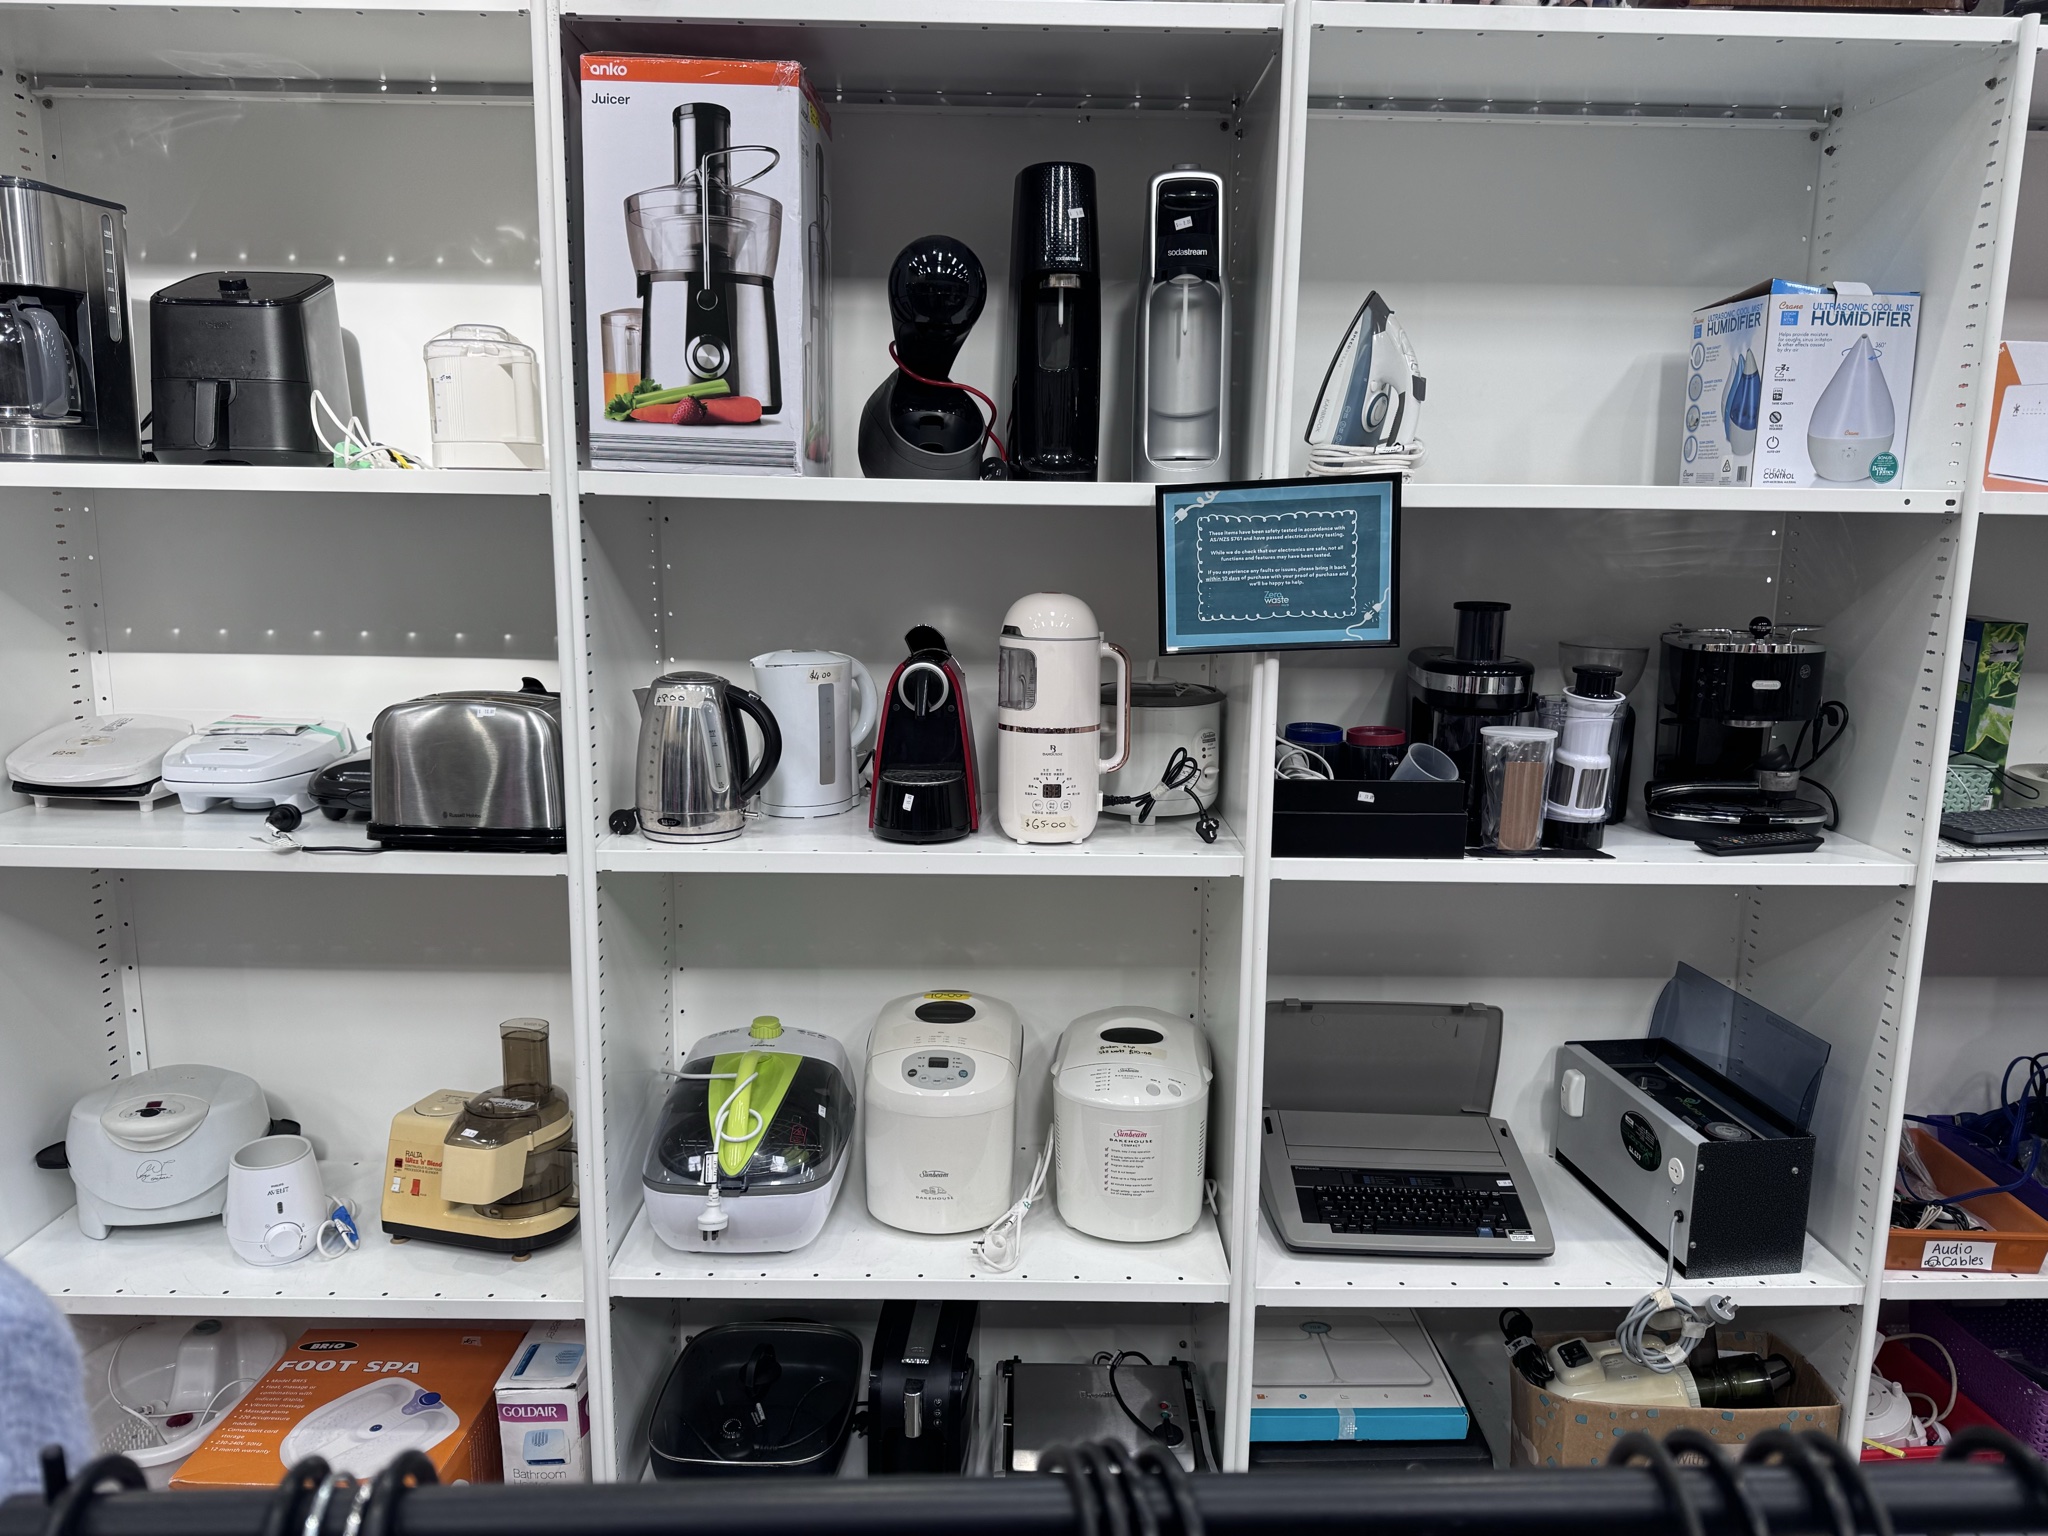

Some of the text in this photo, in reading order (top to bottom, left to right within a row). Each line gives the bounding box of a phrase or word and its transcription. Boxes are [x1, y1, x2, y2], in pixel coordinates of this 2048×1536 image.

[590, 62, 627, 76] anko
[592, 93, 630, 104] Juicer
[1168, 248, 1207, 256] sodastream
[1813, 303, 1868, 311] ULTRASONIC
[1896, 304, 1914, 312] MIST
[1708, 310, 1736, 322] ULTRASONIC
[1737, 307, 1750, 315] COOL
[1811, 311, 1911, 327] HUMIDIFIER
[1707, 312, 1760, 336] HUMIDIFIER
[1114, 1129, 1147, 1137] Sunbeam
[405, 1150, 422, 1158] RALTA
[919, 1170, 949, 1178] Sunbeam
[1932, 1243, 1972, 1255] Audio
[1942, 1255, 1983, 1267] Cables
[276, 1360, 420, 1373] FOOT SPA
[502, 1406, 557, 1418] GOLDAIR
[513, 1468, 566, 1480] Bathroom
